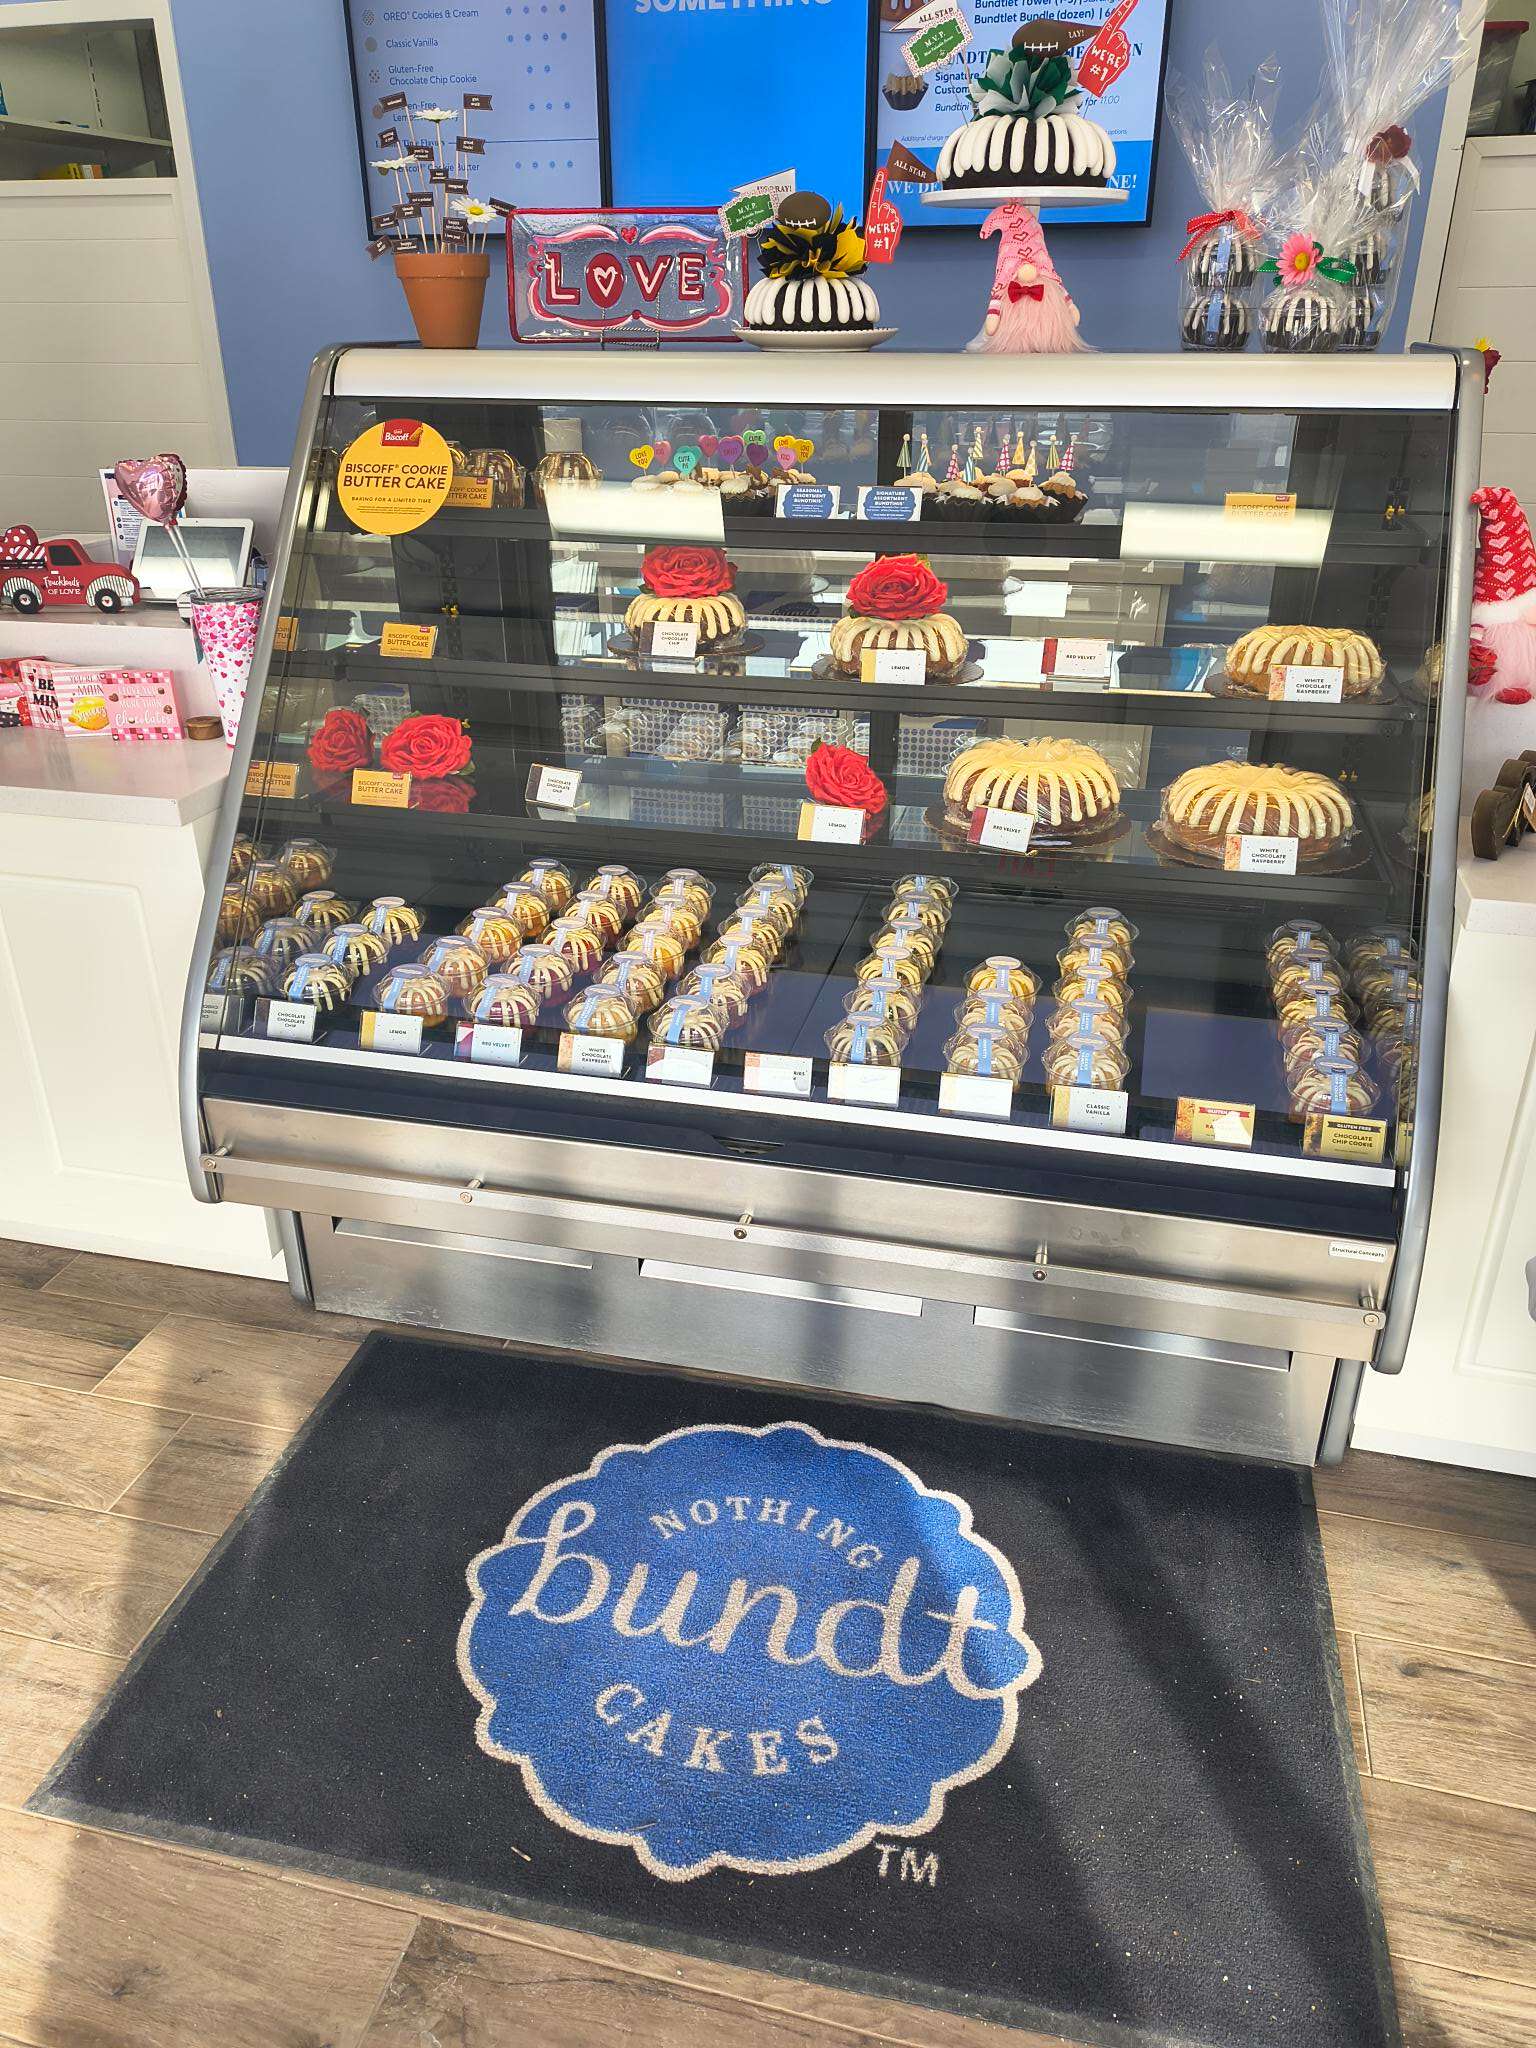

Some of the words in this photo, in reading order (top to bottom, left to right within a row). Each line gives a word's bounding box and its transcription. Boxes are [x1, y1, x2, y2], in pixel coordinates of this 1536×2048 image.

[412, 10, 443, 20] Cookies
[444, 10, 450, 18] &
[453, 9, 479, 17] Cream
[919, 14, 933, 23] ALL
[974, 13, 1018, 24] Bundtlet
[1020, 10, 1054, 22] Bundle
[1057, 8, 1094, 20] (dozen)
[385, 40, 412, 49] Classic
[412, 38, 438, 48] Vanilla
[1091, 46, 1122, 68] WE'RE
[388, 64, 434, 74] Gluten-Free
[1090, 64, 1108, 81] #1
[389, 76, 428, 86] Chocolate
[430, 75, 448, 86] Chip
[450, 74, 477, 84] Cookie
[894, 159, 908, 171] ALL
[907, 165, 926, 179] STAR
[888, 181, 914, 196] WE
[868, 221, 896, 235] WE'RE
[873, 236, 890, 250] #1
[546, 251, 706, 309] LOVE
[384, 432, 410, 442] Biscoff
[401, 465, 448, 475] COOKIE
[343, 475, 400, 488] BUTTER
[405, 477, 447, 489] CAKE
[387, 639, 411, 647] BUTTER
[412, 640, 429, 648] CAKE
[38, 679, 54, 691] BE
[385, 787, 403, 795] CAKE
[277, 1017, 305, 1025] CHOCOLATE
[278, 1012, 305, 1020] CHOCOLATE
[582, 1052, 612, 1060] CHOCOLATE
[1332, 1138, 1347, 1146] CHIP
[1349, 1140, 1373, 1148] COOKIE
[1333, 1132, 1373, 1142] CHOCOLATE
[1332, 1246, 1357, 1255] Structural
[1358, 1249, 1385, 1258] Concepts
[650, 1496, 884, 1570] NOTHING
[507, 1500, 1004, 1700] bundt
[595, 1682, 840, 1777] CAKES
[873, 1843, 939, 1886] TM
